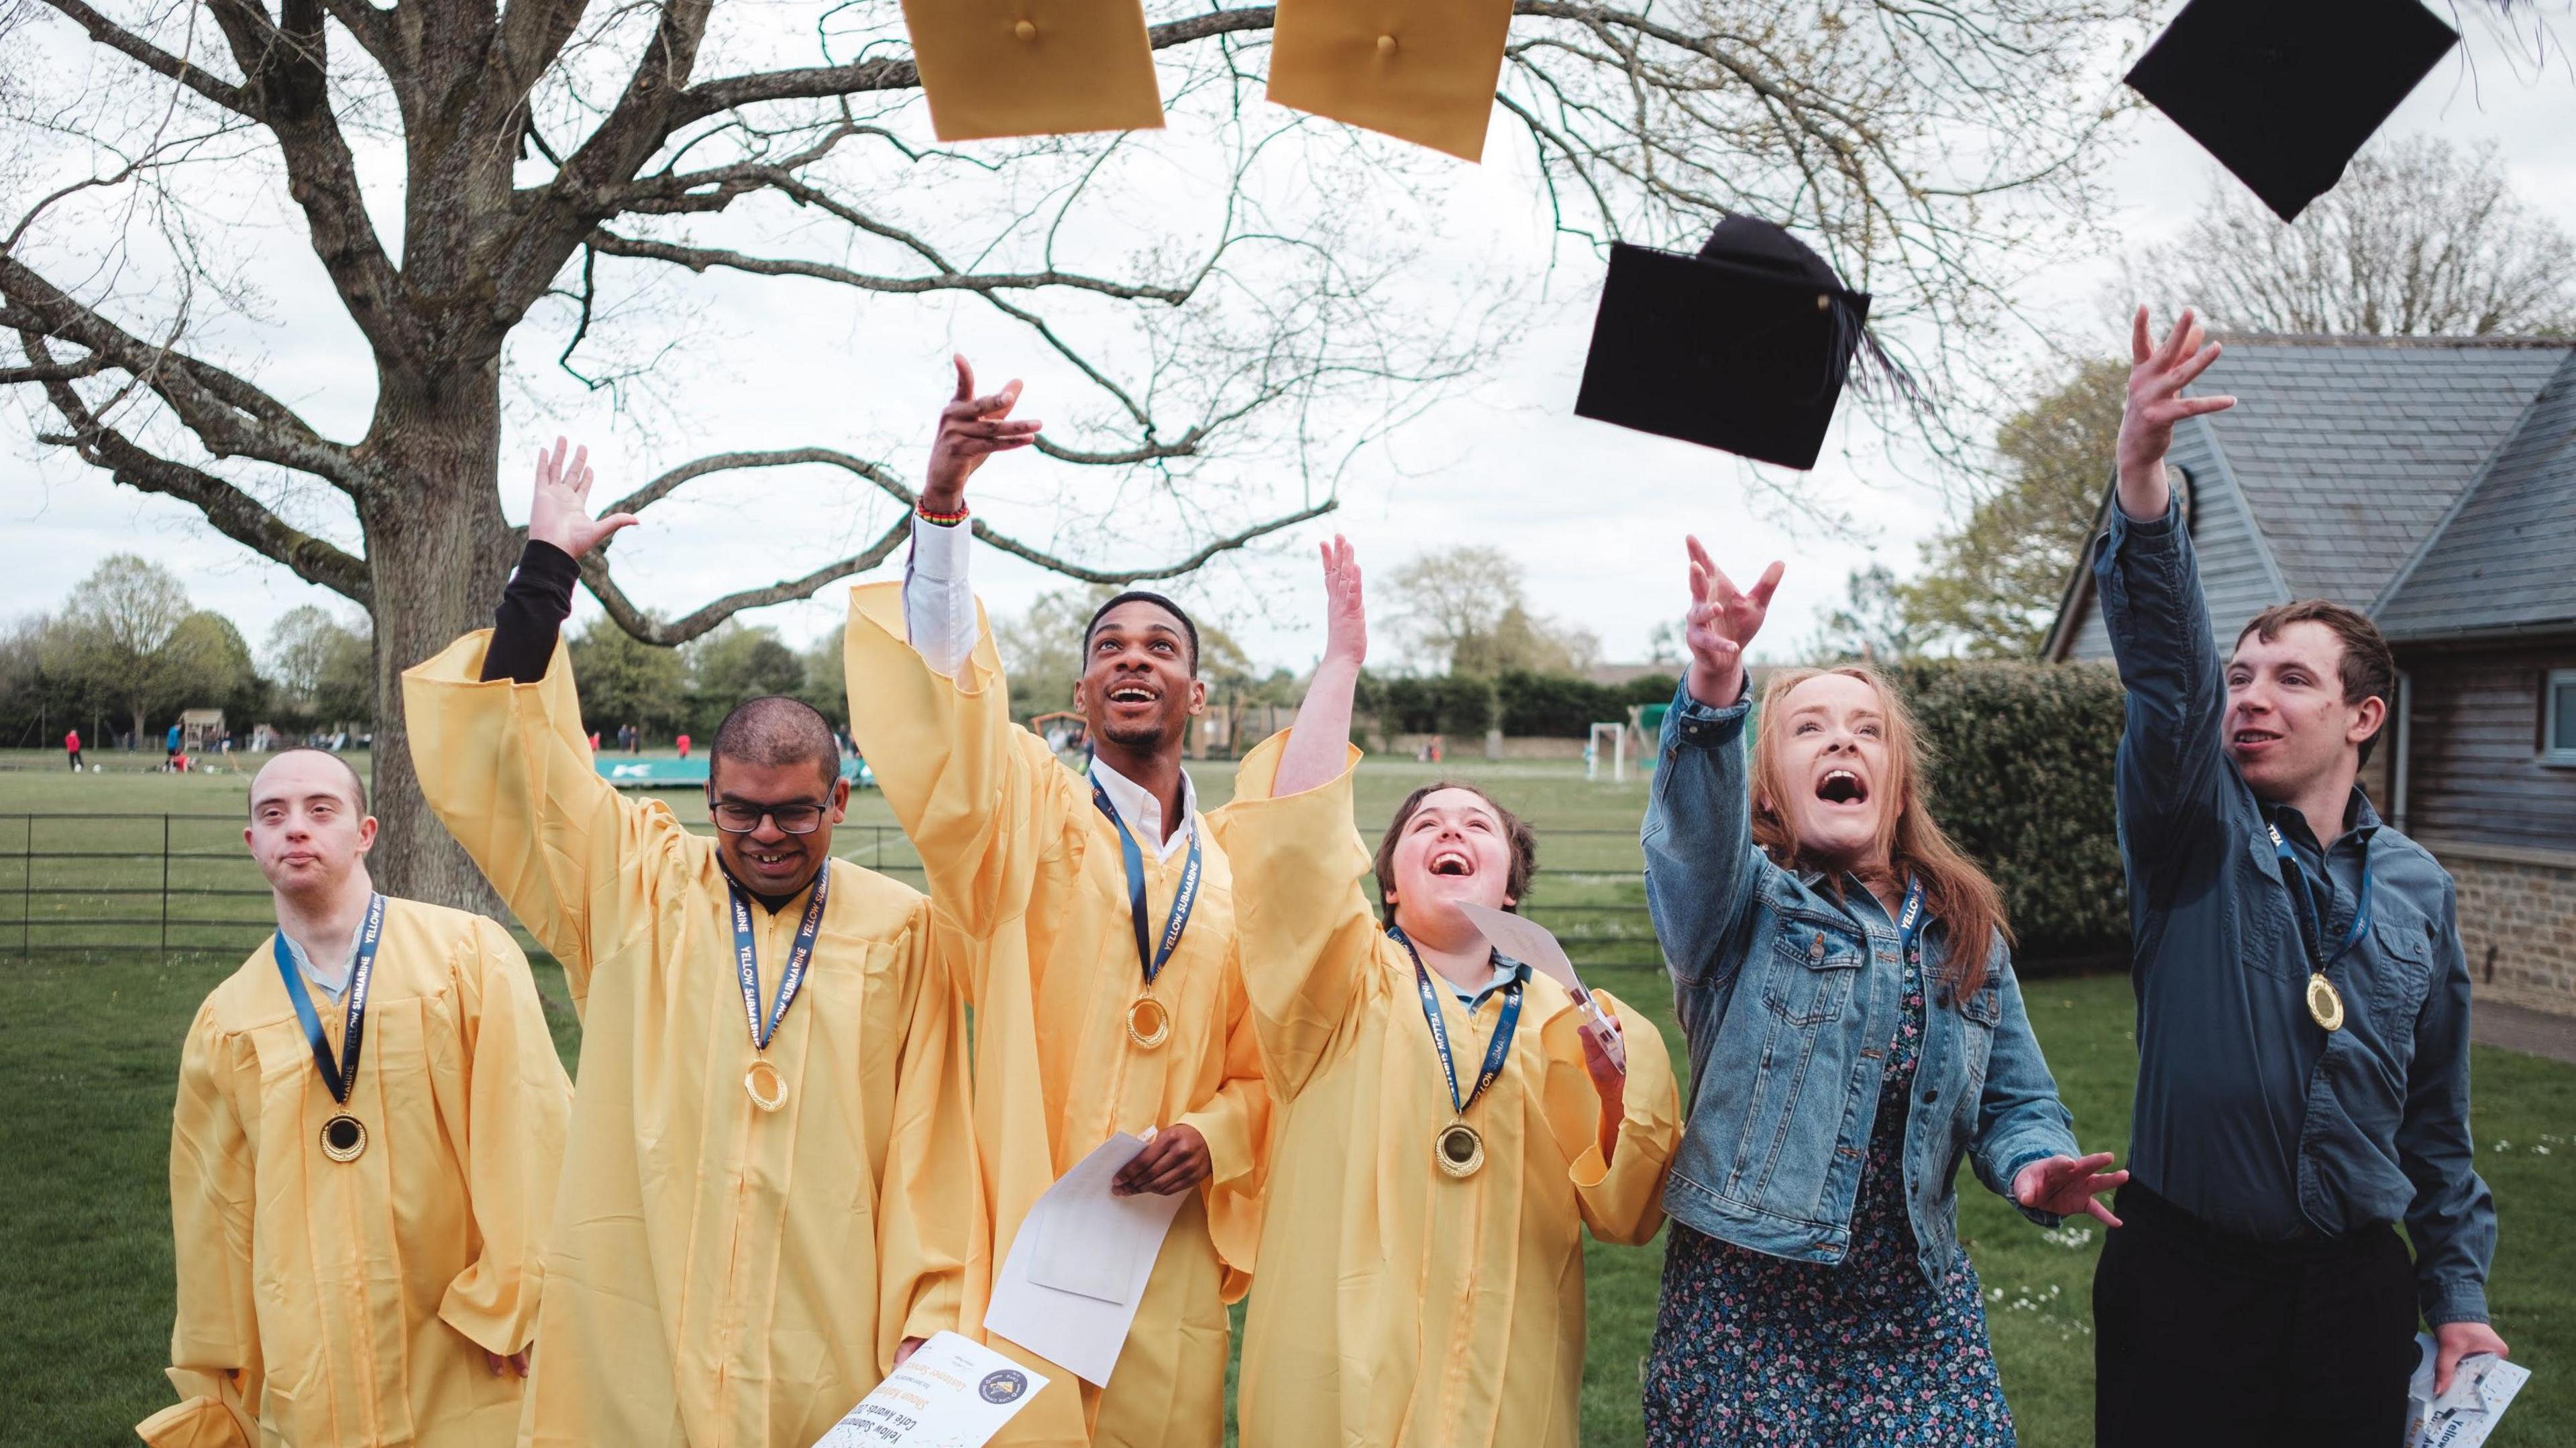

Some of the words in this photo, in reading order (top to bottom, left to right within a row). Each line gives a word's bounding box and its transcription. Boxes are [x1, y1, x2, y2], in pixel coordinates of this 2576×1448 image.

[802, 903, 820, 938] YELLOW
[1164, 913, 1183, 950] YELLOW
[1177, 860, 1199, 913] SUBMARINE
[1900, 893, 1919, 930] YELLOW
[365, 909, 380, 944] YELLOW
[353, 956, 370, 1010] SUBMARINE
[741, 946, 754, 987] YELLOW
[782, 947, 807, 1001] SUBMARINE
[347, 1011, 360, 1052] YELLOW
[1430, 1013, 1446, 1050] YELLOW
[1489, 1019, 1512, 1072] SUBMARINE
[867, 1405, 897, 1421] Awards
[892, 1414, 917, 1431] Café
[873, 1425, 902, 1445] Yellow
